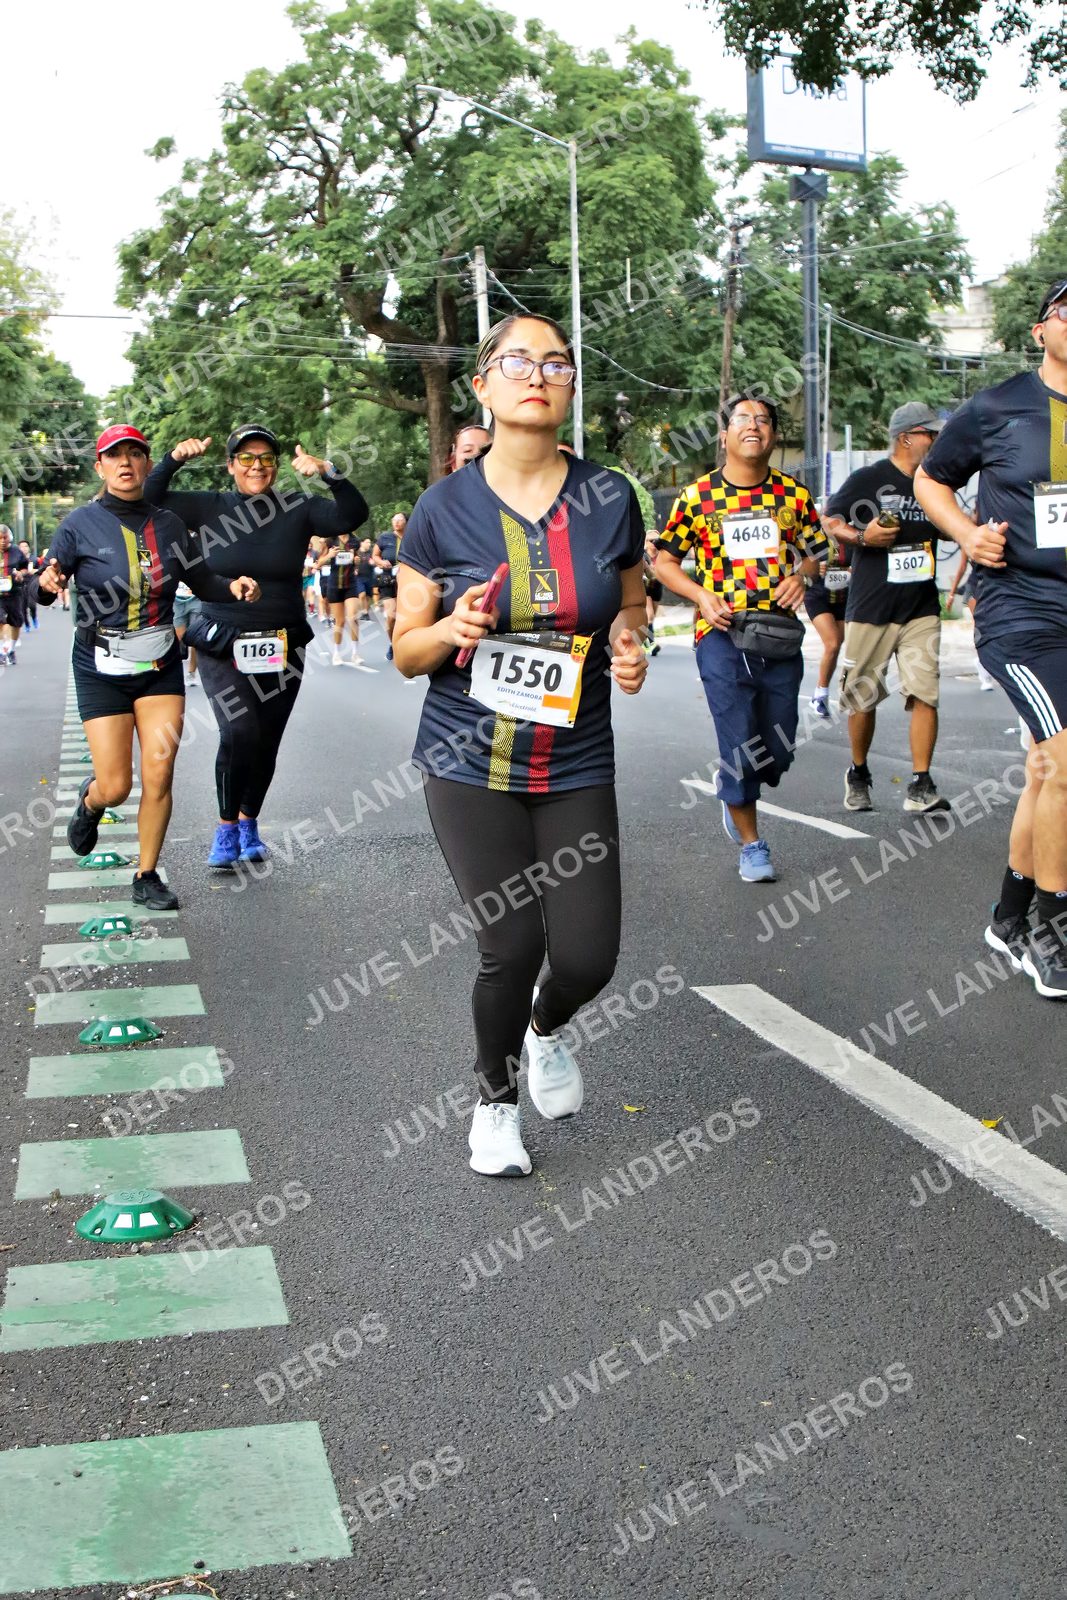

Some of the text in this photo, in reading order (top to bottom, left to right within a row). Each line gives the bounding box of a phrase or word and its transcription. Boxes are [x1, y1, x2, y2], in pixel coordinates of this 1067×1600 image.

[732, 524, 771, 543] 4648
[894, 556, 925, 571] 3607
[828, 574, 848, 583] 5809
[241, 643, 275, 658] 1163
[490, 651, 562, 692] 1550
[517, 690, 543, 701] ZAMORA
